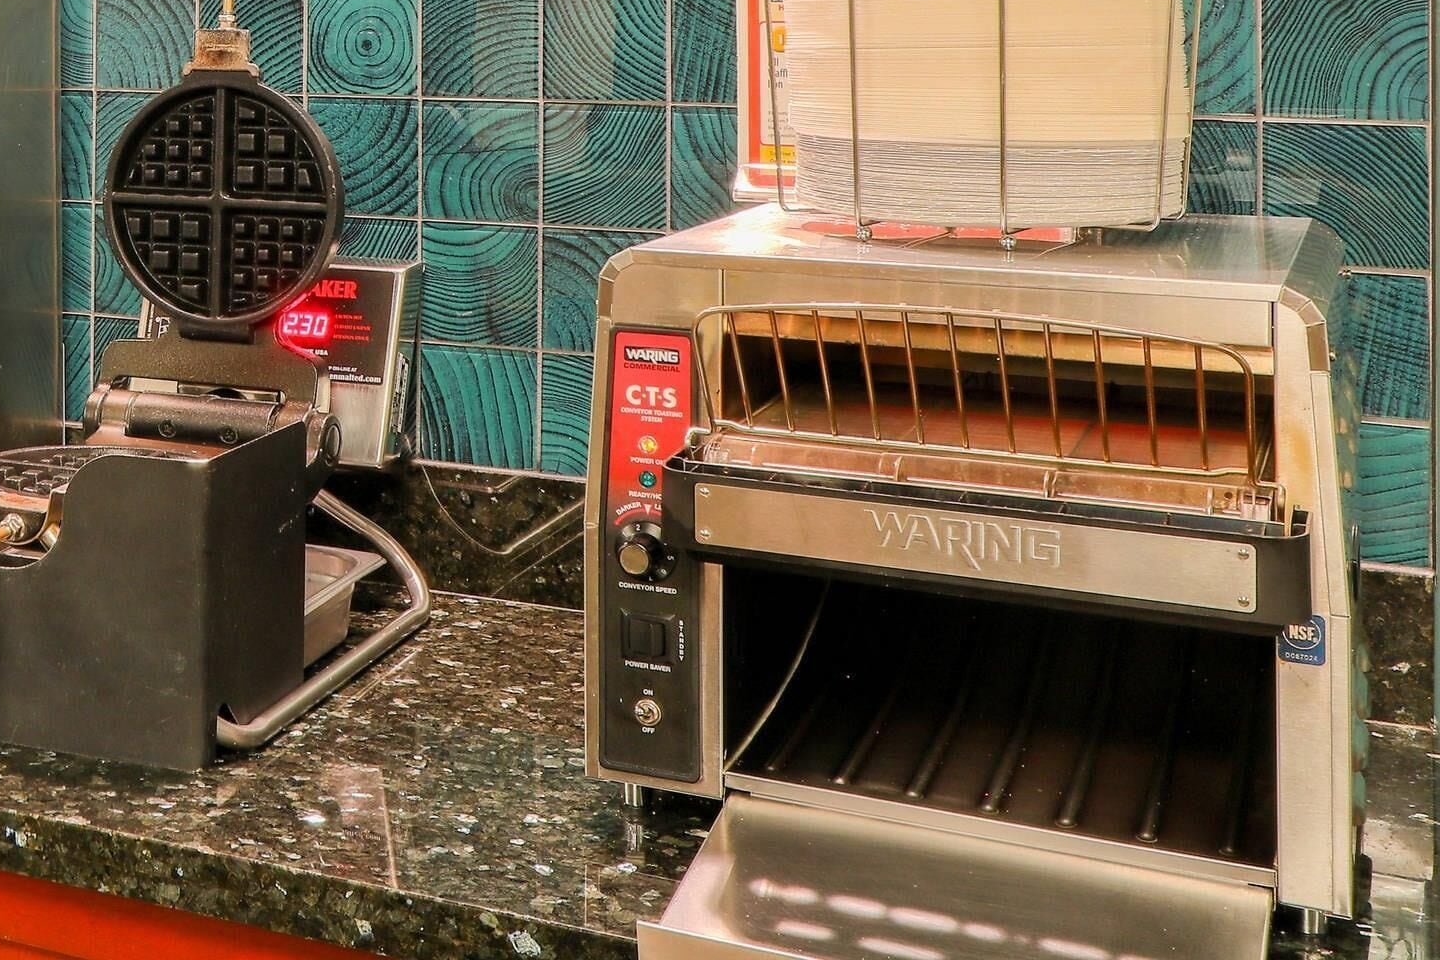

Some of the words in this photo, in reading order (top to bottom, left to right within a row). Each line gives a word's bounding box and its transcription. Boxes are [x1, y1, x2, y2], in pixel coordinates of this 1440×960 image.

[625, 347, 679, 364] WARING
[623, 362, 680, 372] COMMERCIAL
[621, 407, 653, 416] CONVEYOR
[654, 409, 683, 418] TOASTING
[641, 415, 663, 423] SYSTEM
[630, 456, 654, 464] POWER
[615, 501, 642, 516] DARKER
[635, 524, 641, 532] 2
[864, 508, 1061, 571] WARING
[619, 581, 654, 592] CONVEYOR
[655, 586, 678, 595] SPEED
[1289, 624, 1315, 641] NSF
[625, 660, 649, 669] POWER
